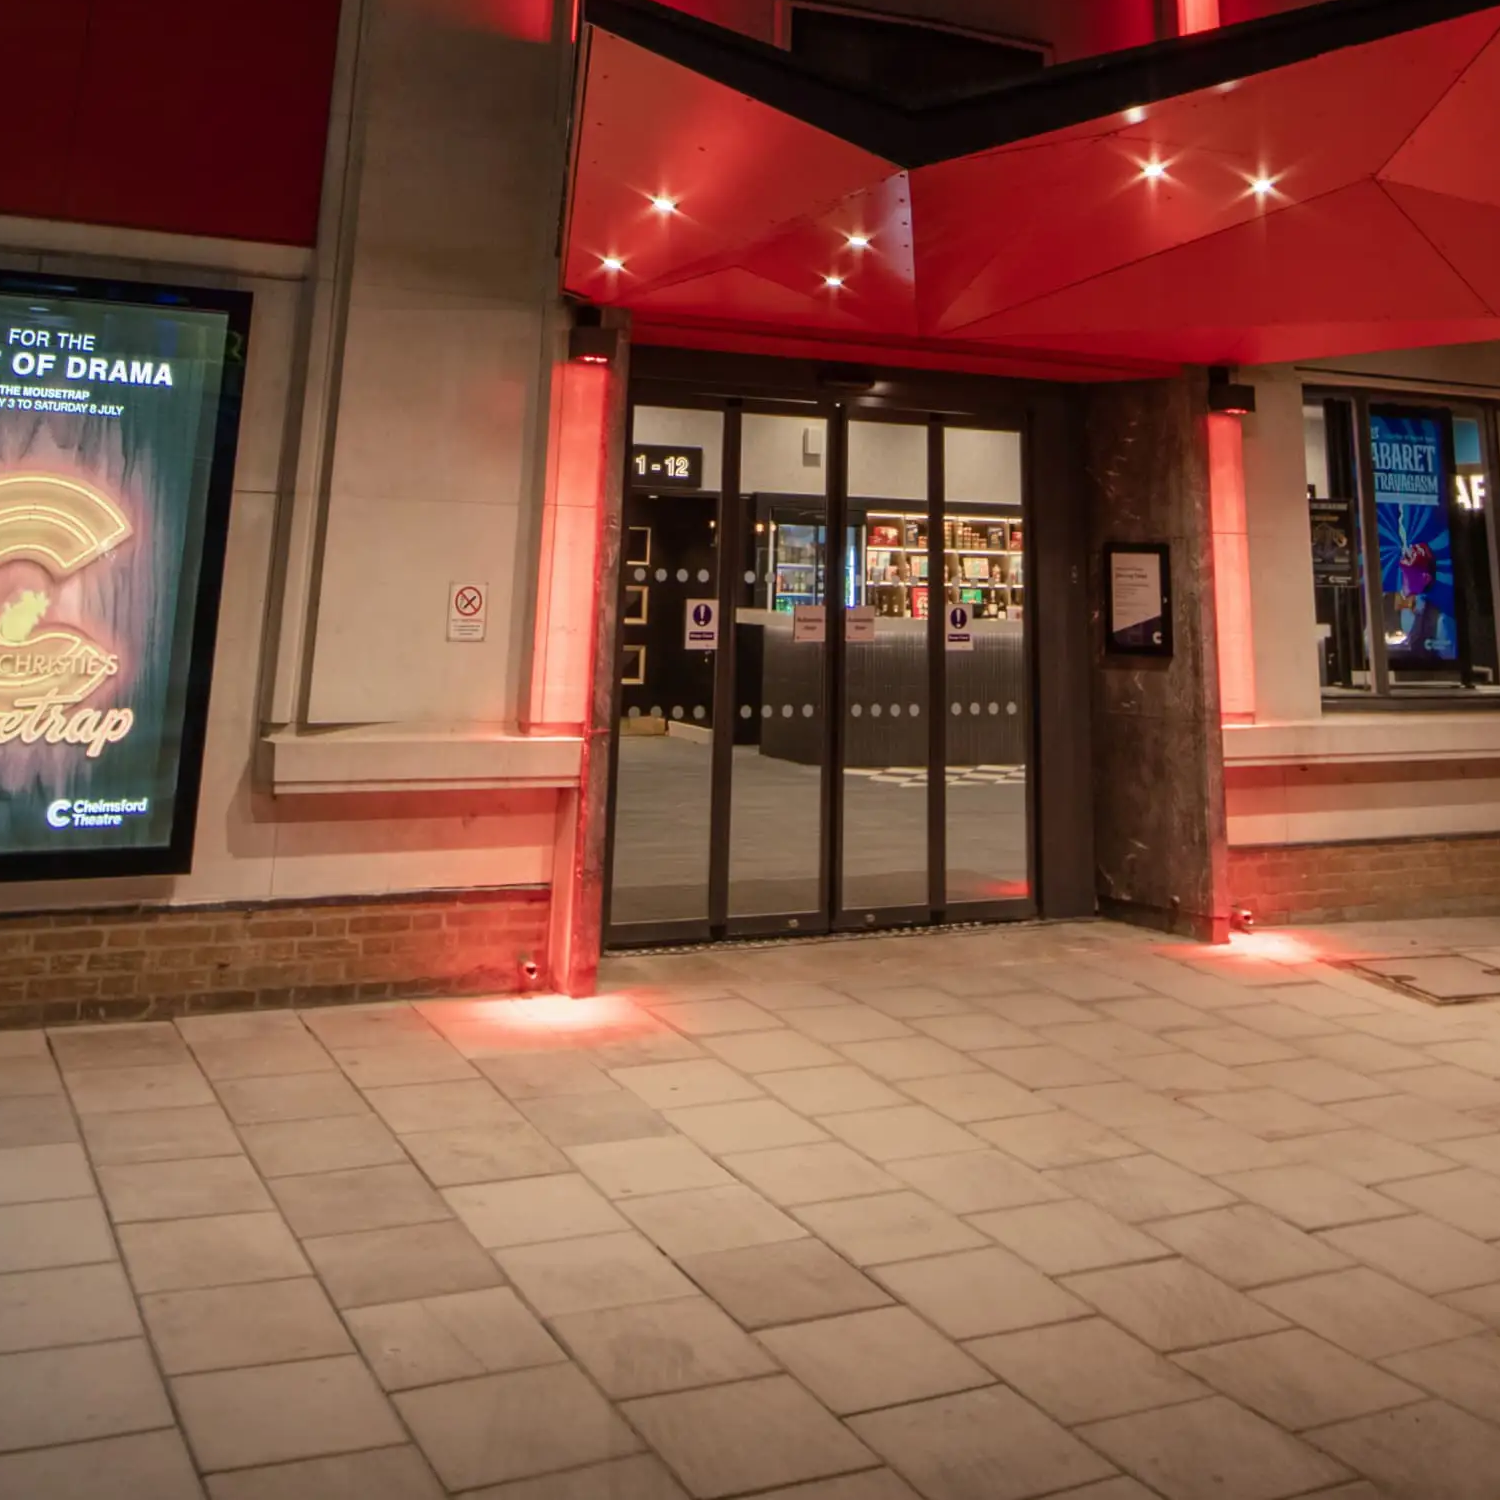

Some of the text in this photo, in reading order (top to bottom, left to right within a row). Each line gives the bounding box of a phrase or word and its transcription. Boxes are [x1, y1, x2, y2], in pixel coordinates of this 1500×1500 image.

[8, 328, 96, 351] FOR THE
[12, 352, 56, 377] OF
[66, 357, 174, 386] DRAMA
[0, 385, 90, 401] THE MOUSETRAP
[7, 398, 15, 409] 3
[17, 398, 31, 410] TO
[34, 400, 87, 414] SATURDAY
[89, 404, 96, 414] 8
[97, 404, 124, 416] JULY
[635, 454, 646, 475] 1
[664, 456, 689, 477] 12
[73, 797, 148, 813] Chelmsford
[72, 814, 123, 827] Theatre
